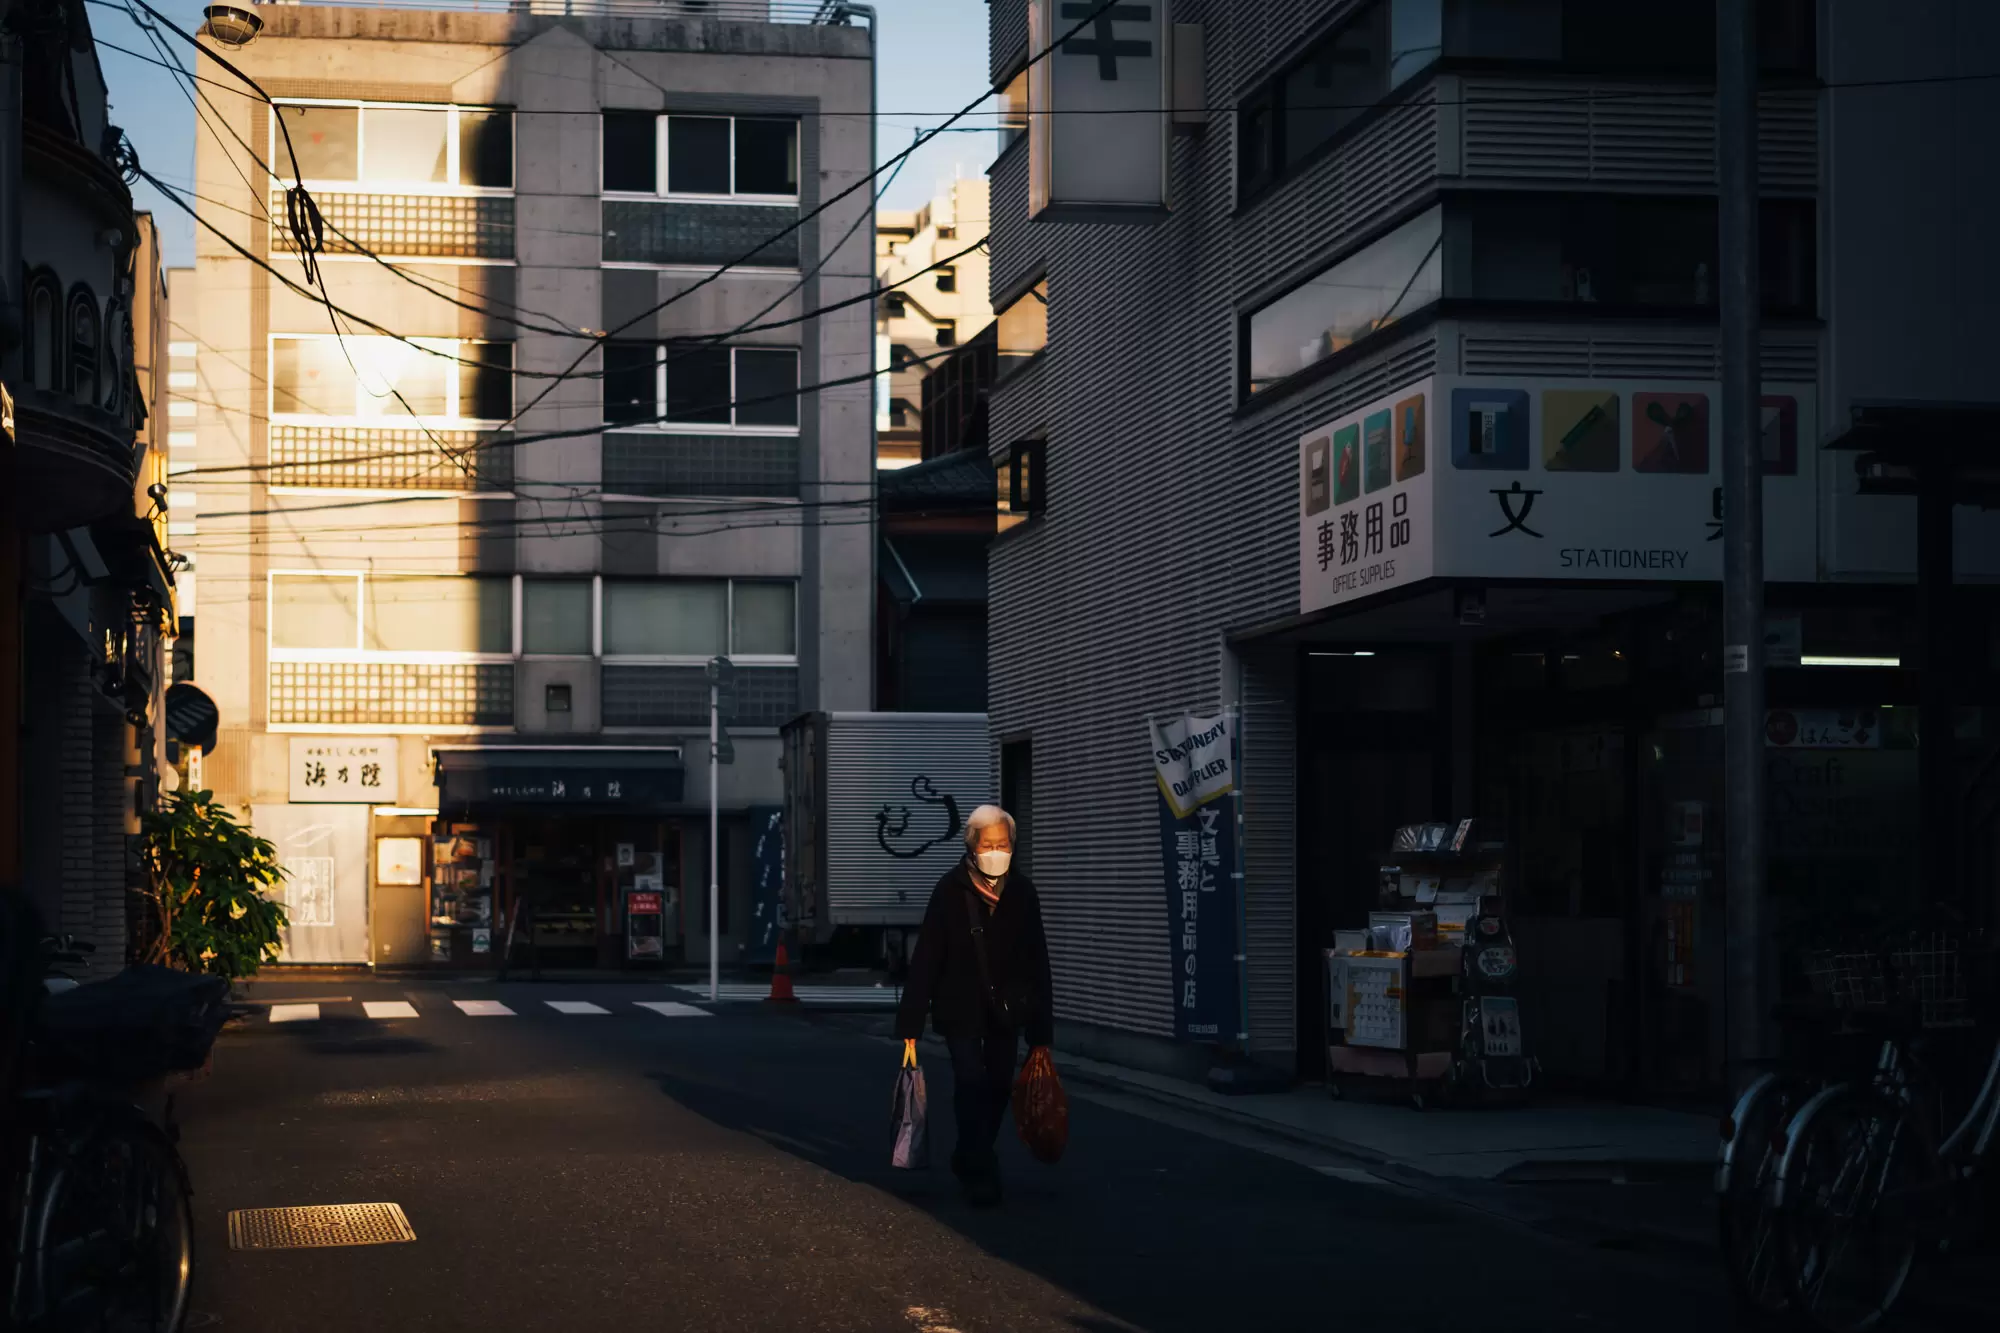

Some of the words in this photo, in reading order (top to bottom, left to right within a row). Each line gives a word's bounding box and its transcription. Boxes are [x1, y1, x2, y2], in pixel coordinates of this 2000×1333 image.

[1316, 492, 1411, 572] 事務用品
[1332, 571, 1356, 594] OFFICE
[1359, 559, 1396, 587] SUPPLIES
[1560, 549, 1689, 569] STATIONERY
[1156, 719, 1226, 765] STATONERY
[1800, 727, 1852, 745] はんこ
[1196, 807, 1221, 892] 文具と
[1174, 829, 1200, 1010] 事務用品の店
